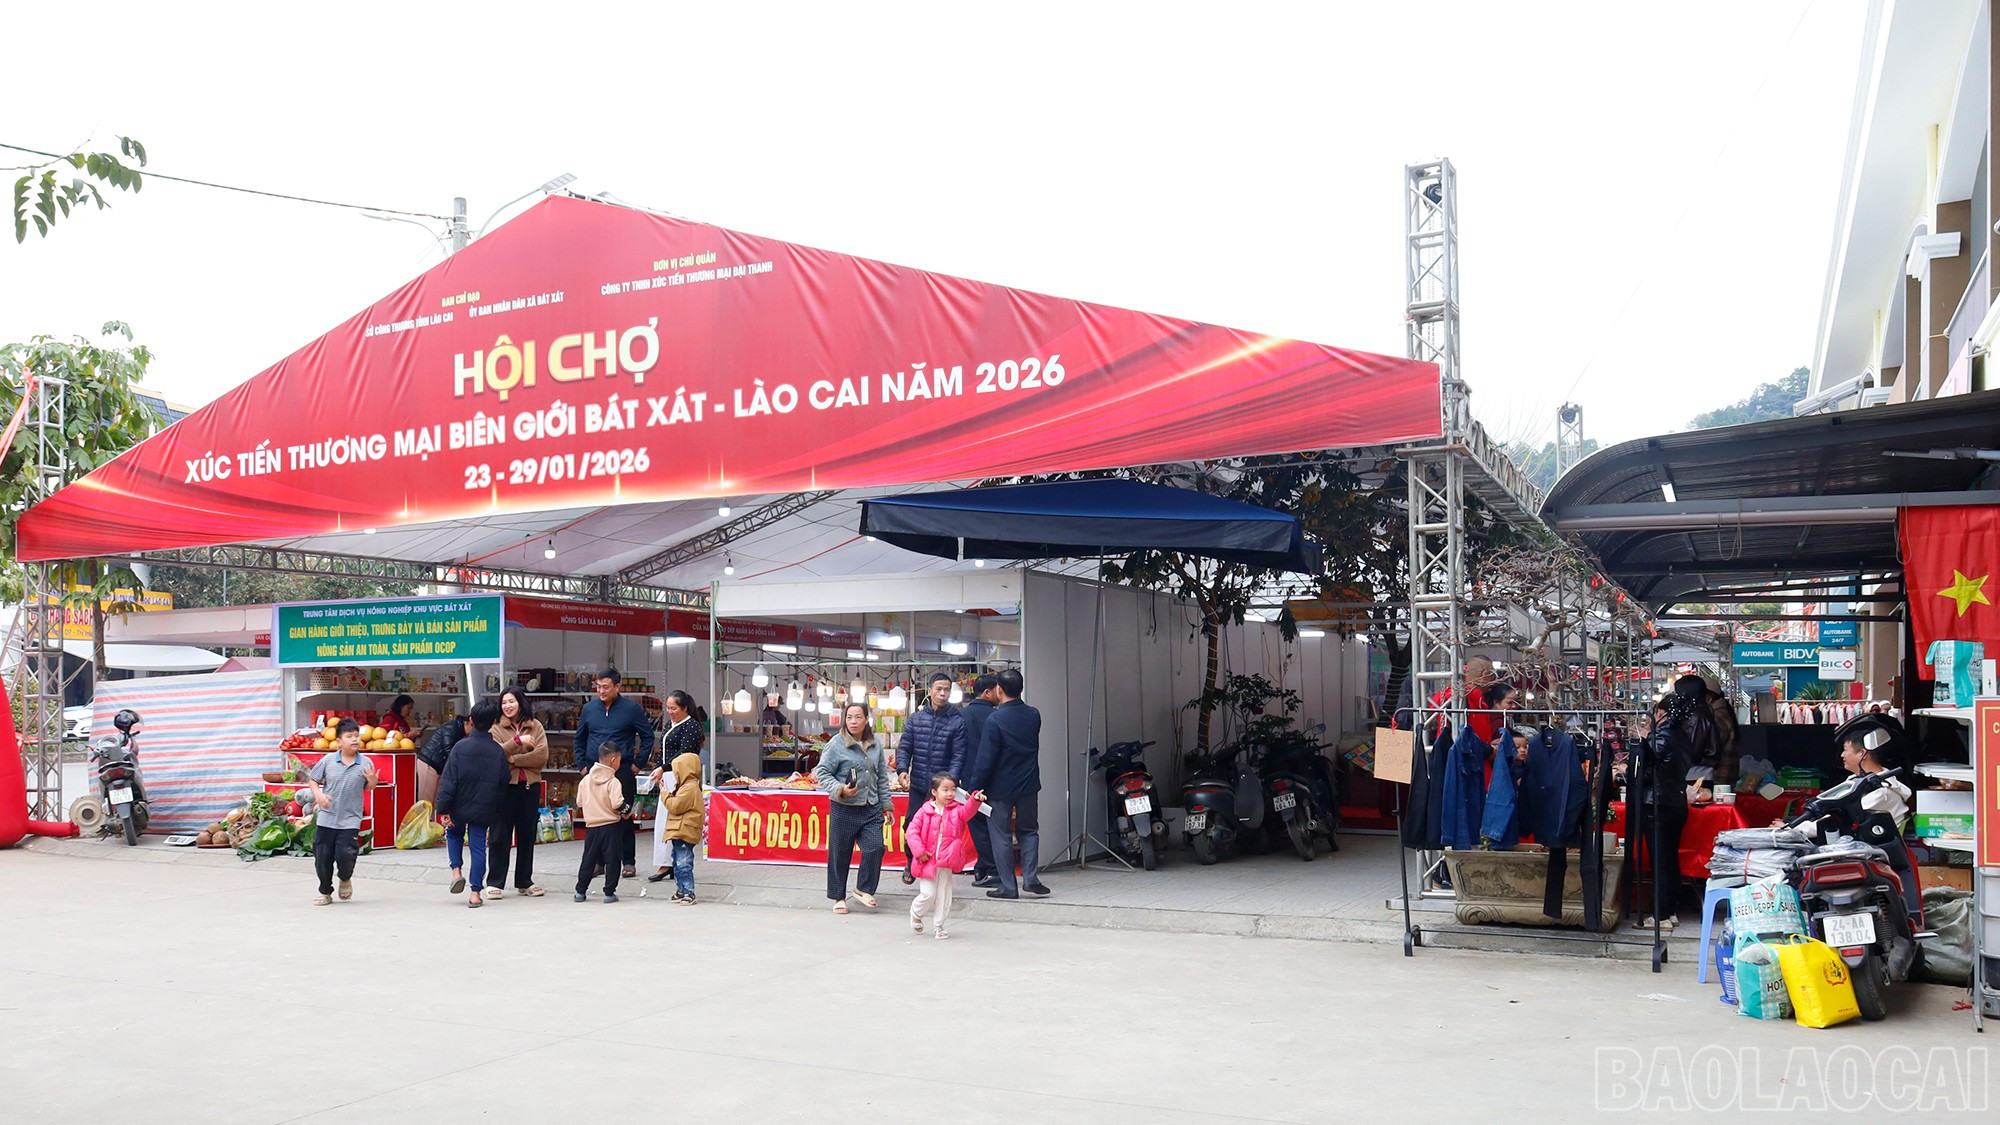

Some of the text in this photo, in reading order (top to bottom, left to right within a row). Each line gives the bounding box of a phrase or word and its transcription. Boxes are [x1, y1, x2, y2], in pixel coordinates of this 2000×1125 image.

[654, 251, 716, 271] ĐƠN VỊ CHỦ QUẢN
[601, 262, 772, 295] CÔNG TY TNHH XÚC TIẾN THƯƠNG MẠI ĐẠI THANH
[442, 291, 480, 307] BAN CHỈ ĐẠO
[469, 291, 564, 318] ỦY BAN NHÂN DÂN XÃ BÁT XÁT
[366, 312, 453, 337] SỞ CÔNG THƯƠNG TỈNH LÀO CAI
[454, 316, 660, 401] HỘI CHỢ
[184, 354, 1066, 484] XÚC TIẾN THƯƠNG MẠI BIÊN GIỚI BÁT XÁT - LÀO CAI NĂM 2026
[464, 447, 650, 490] 23 - 29/01/2026
[303, 602, 472, 618] TRUNG TÂM DỊCH VỤ NÔNG NGHIỆP KHU VỰC BÁT XÁT
[561, 615, 577, 624] NÔNG
[289, 614, 487, 639] GIAN HÀNG GIỚI THIỆU, TRƯNG BÀY VÀ BÁN SẢN PHẨM
[316, 638, 456, 657] NÔNG SẢN AN TOÀN, SẢN PHẨM OCOP
[1784, 648, 1815, 659] BIDV
[725, 810, 761, 855] KẸO
[766, 800, 802, 850] DẺO
[808, 805, 820, 850] Ô
[1734, 904, 1753, 917] GREEN
[1780, 901, 1797, 913] SAUCE
[1832, 917, 1865, 931] 24-AA
[1831, 930, 1871, 945] 138.04
[1767, 978, 1783, 992] HOT
